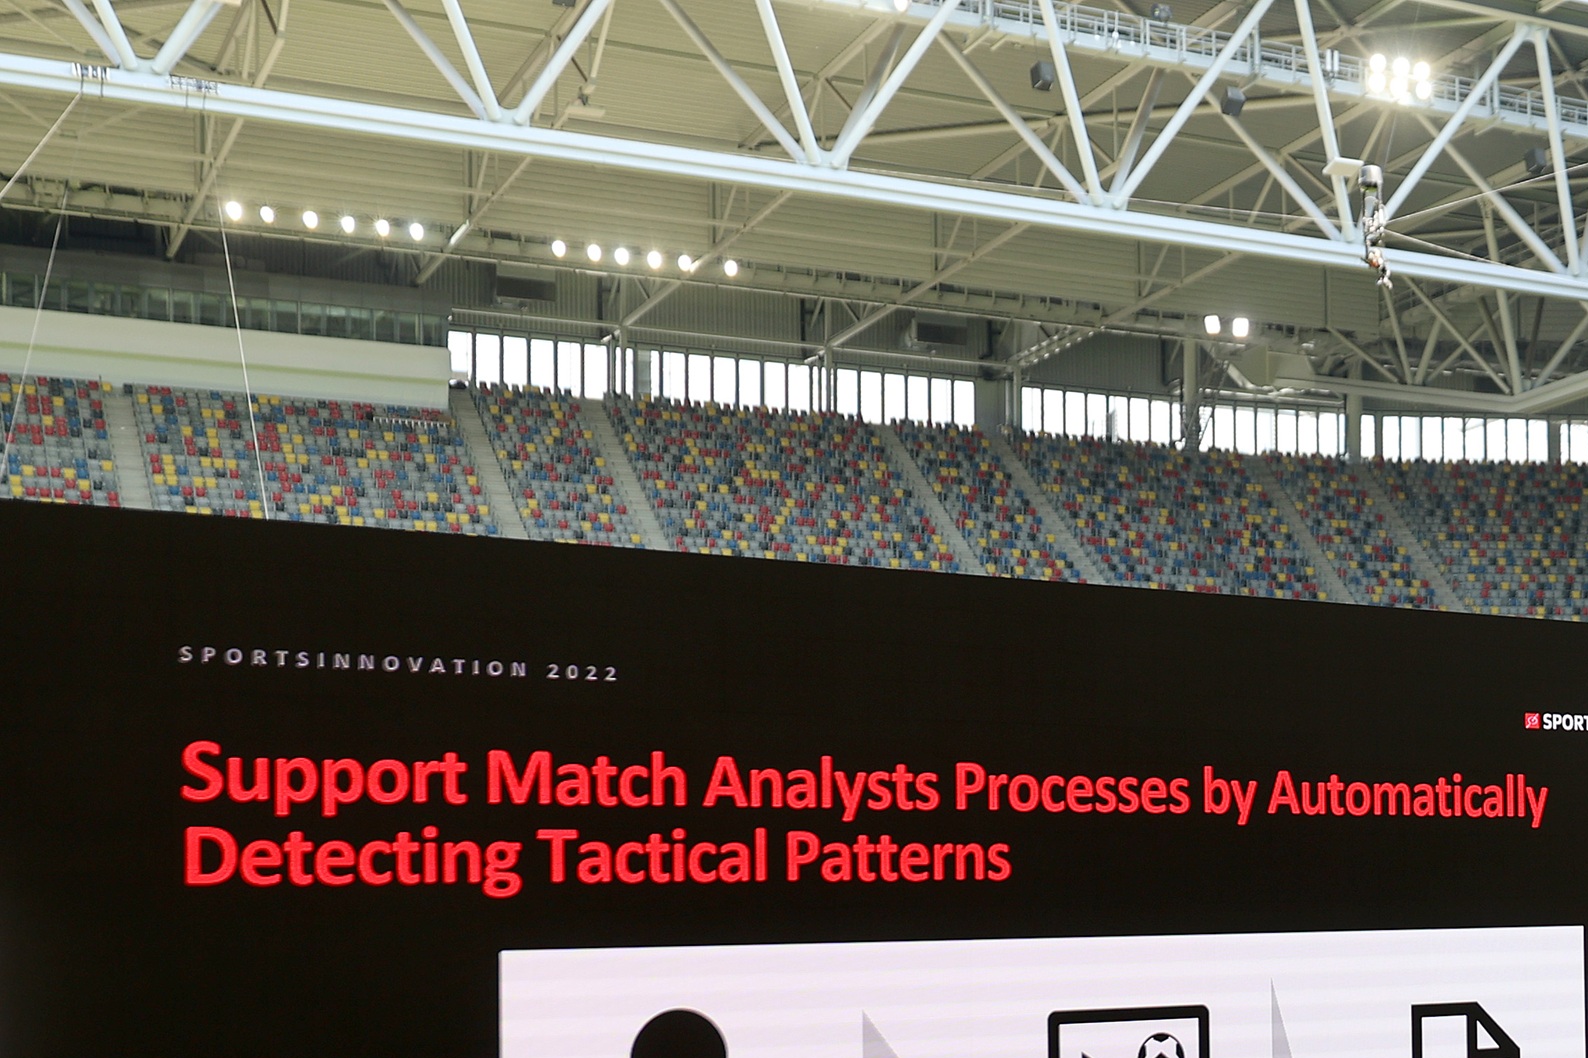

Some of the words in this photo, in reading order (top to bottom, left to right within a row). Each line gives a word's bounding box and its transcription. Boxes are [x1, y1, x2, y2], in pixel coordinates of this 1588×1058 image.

[179, 646, 526, 677] SPORTSINNOVATION
[547, 664, 617, 681] 2022
[181, 741, 468, 817] Support
[488, 750, 687, 807] Match
[702, 756, 940, 822] Analysts
[956, 762, 1188, 818] Processes
[1204, 767, 1257, 825] by
[1268, 770, 1549, 828] Automatically
[185, 826, 522, 898] Detecting
[536, 828, 767, 884] Tactical
[787, 831, 1011, 882] Patterns
